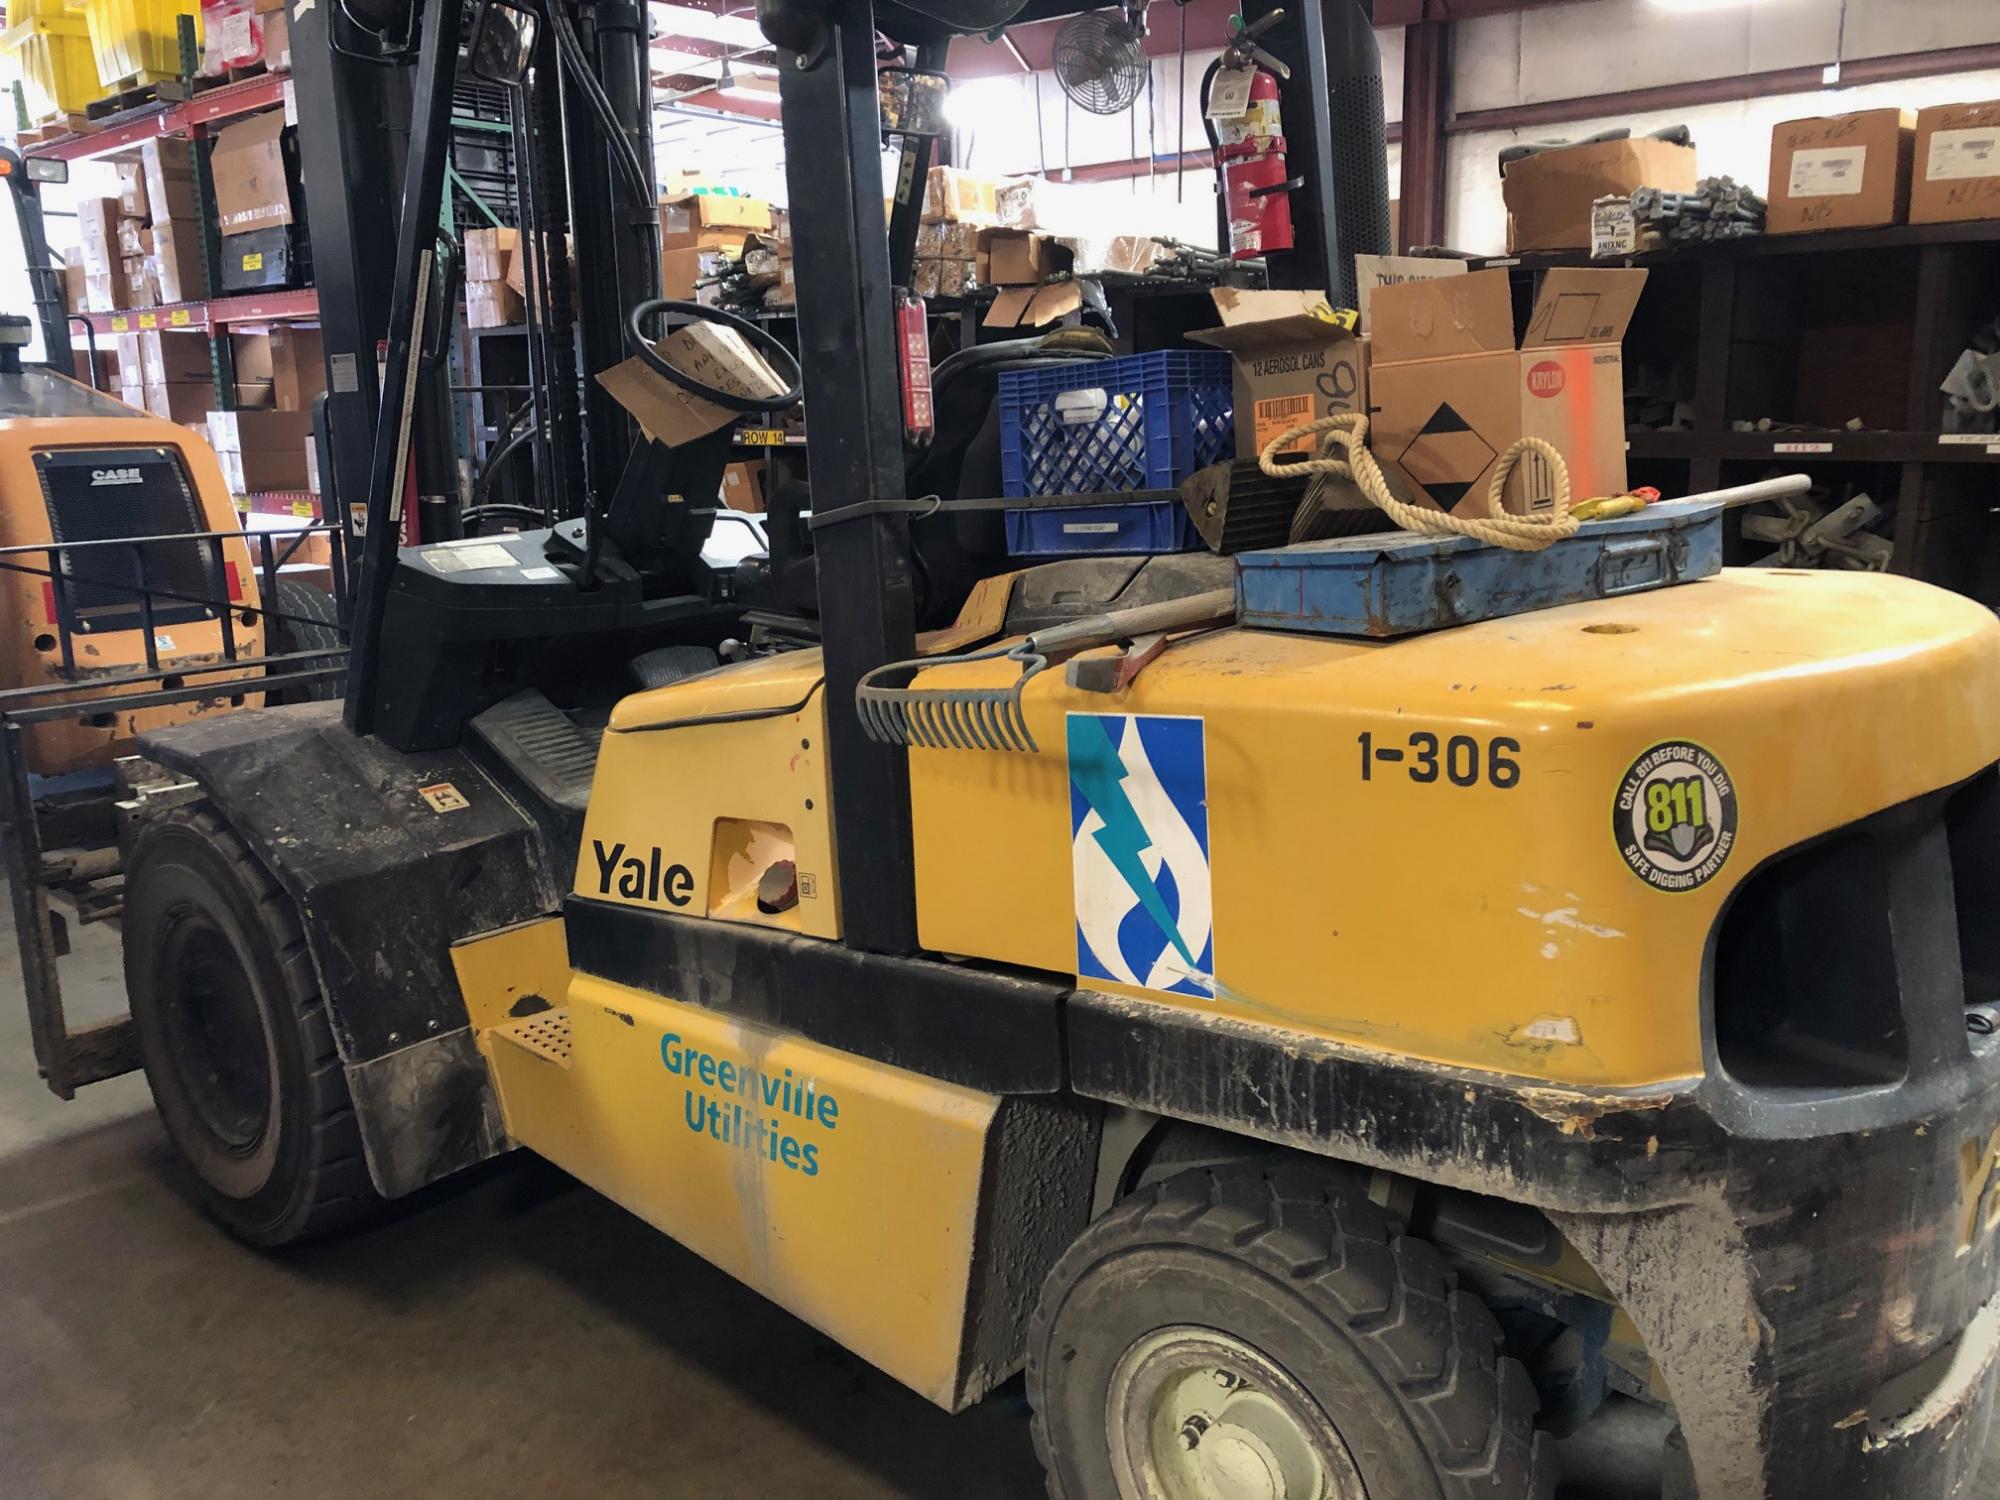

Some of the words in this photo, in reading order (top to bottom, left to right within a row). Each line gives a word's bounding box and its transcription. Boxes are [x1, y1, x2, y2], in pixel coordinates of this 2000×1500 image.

[1253, 360, 1263, 377] 12
[1264, 355, 1302, 376] AEROSOL
[1302, 351, 1326, 370] CANS
[743, 431, 769, 445] ROW
[772, 432, 783, 445] 14
[91, 467, 141, 481] CASE
[1357, 731, 1521, 789] 1-306
[1619, 777, 1641, 811] CALL
[1635, 759, 1654, 778] 811
[1651, 745, 1696, 766] BEFORE
[1696, 751, 1718, 776] YOU
[1712, 772, 1731, 798] DIG
[1647, 779, 1705, 833] 811
[592, 839, 694, 907] Yale
[1624, 843, 1651, 876] SAFE
[1649, 869, 1694, 889] DIGGING
[1695, 830, 1734, 883] PARTNER
[660, 1032, 839, 1130] Greenville
[685, 1089, 819, 1177] Utilities
